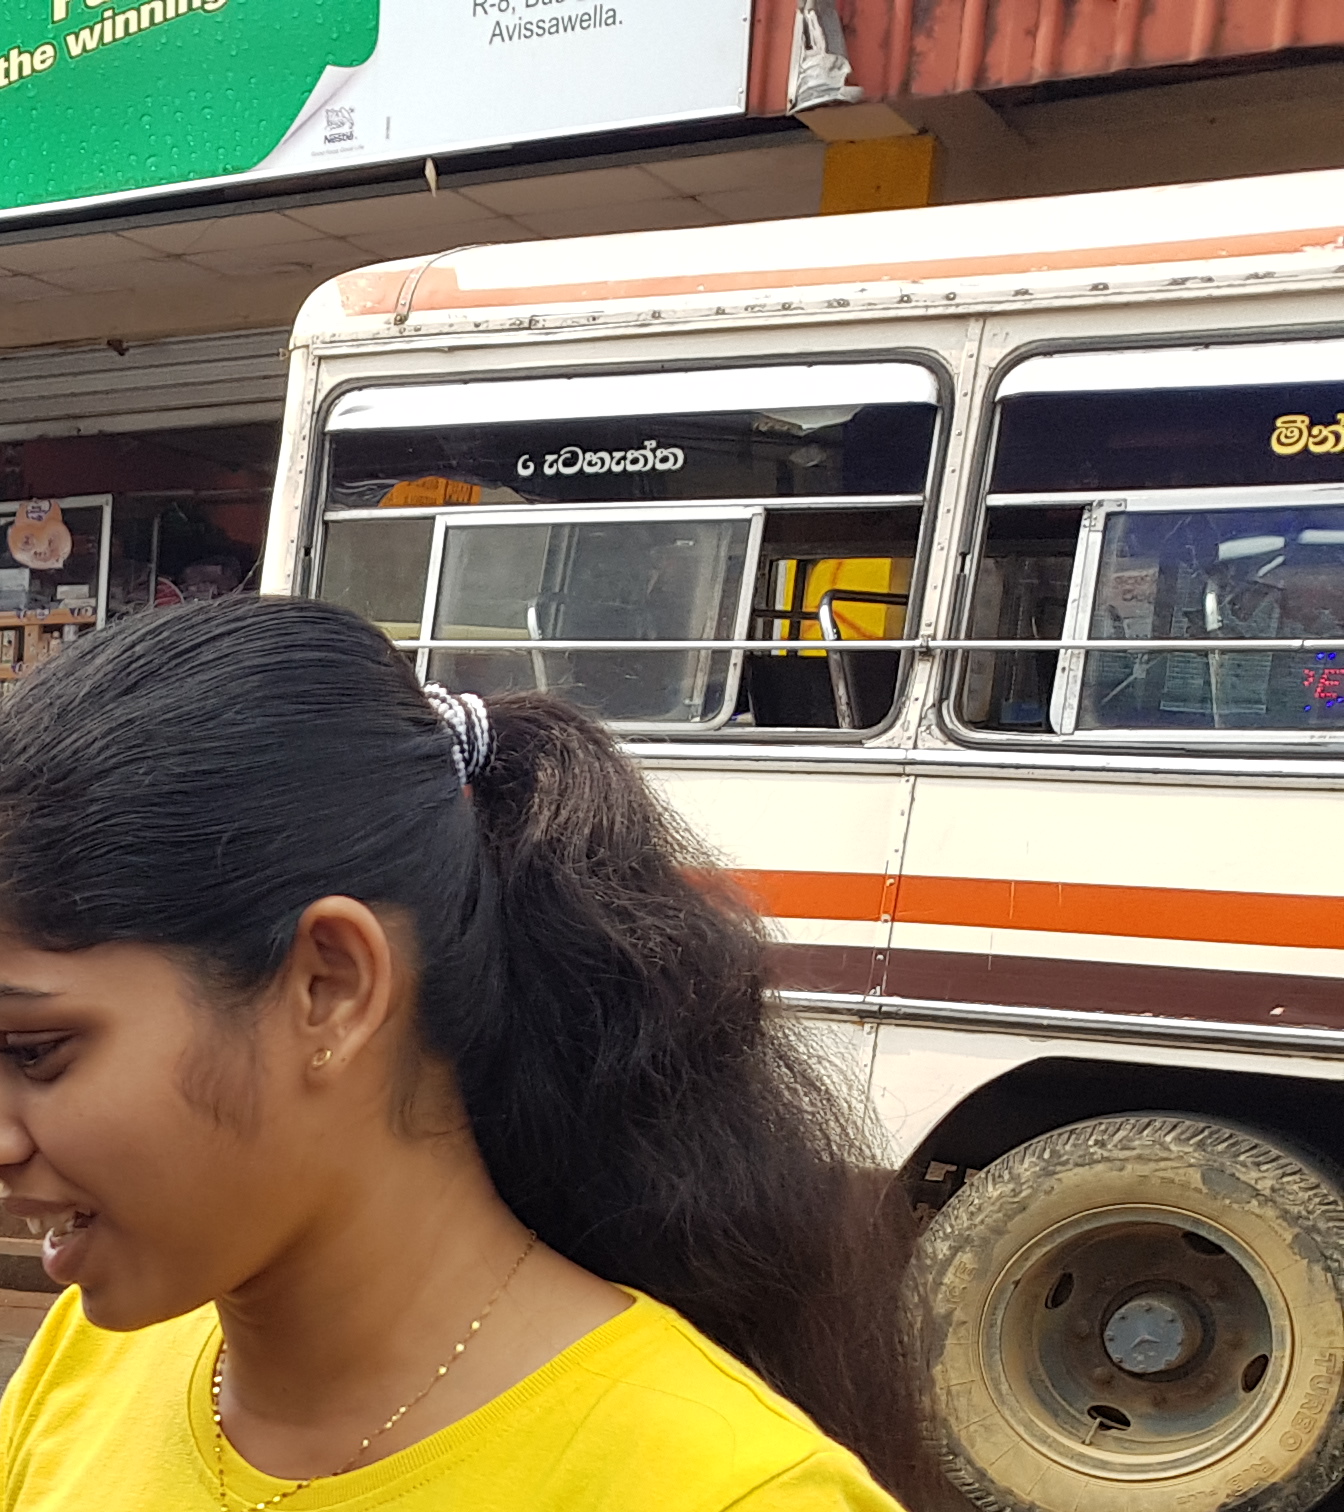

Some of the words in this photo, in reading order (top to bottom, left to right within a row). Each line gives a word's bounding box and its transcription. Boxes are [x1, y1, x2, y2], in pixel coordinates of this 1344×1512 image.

[65, 0, 228, 59] winni
[488, 3, 623, 45] Avissawella.
[1278, 1353, 1337, 1452] TURBO
